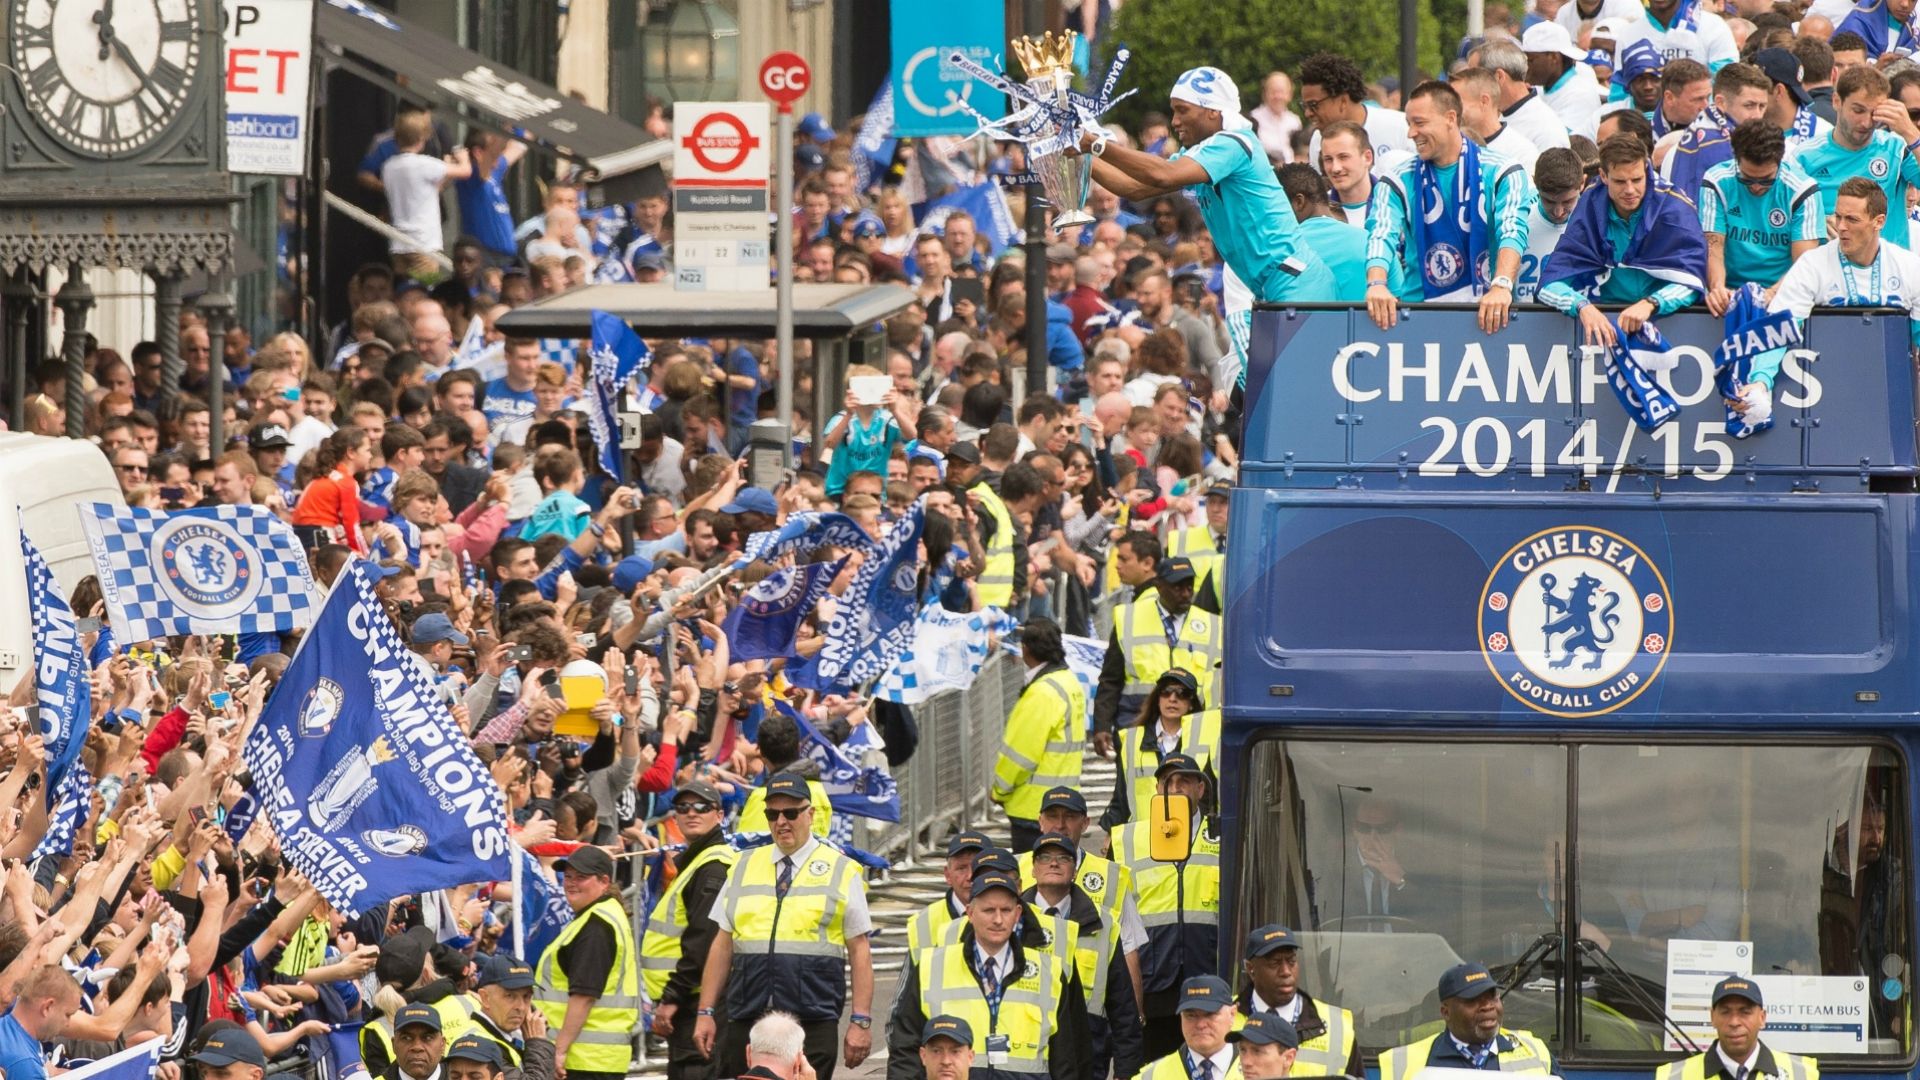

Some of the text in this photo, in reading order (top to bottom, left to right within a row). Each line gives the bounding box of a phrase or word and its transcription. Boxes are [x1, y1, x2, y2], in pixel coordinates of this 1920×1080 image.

[764, 66, 805, 91] GC
[960, 60, 999, 84] BARCLAYS
[697, 137, 742, 147] BUS STOP
[1725, 223, 1790, 247] SAMSUNG
[679, 272, 702, 283] N22
[1331, 341, 1823, 409] CHAMPOS
[1418, 415, 1734, 494] 2014/15
[170, 525, 228, 546] CHELSEA
[1512, 533, 1638, 576] CHELSEA
[183, 586, 241, 603] FOOTBALL CLUB
[1510, 671, 1640, 708] FOOTBALL CLUB
[347, 600, 504, 862] CHAMPIONS
[249, 724, 303, 832] CHELSEA
[389, 728, 411, 754] blue
[402, 750, 423, 772] flag
[415, 767, 441, 796] flying
[436, 791, 457, 815] high
[1798, 1004, 1834, 1016] TEAM
[1836, 1005, 1861, 1016] BUS
